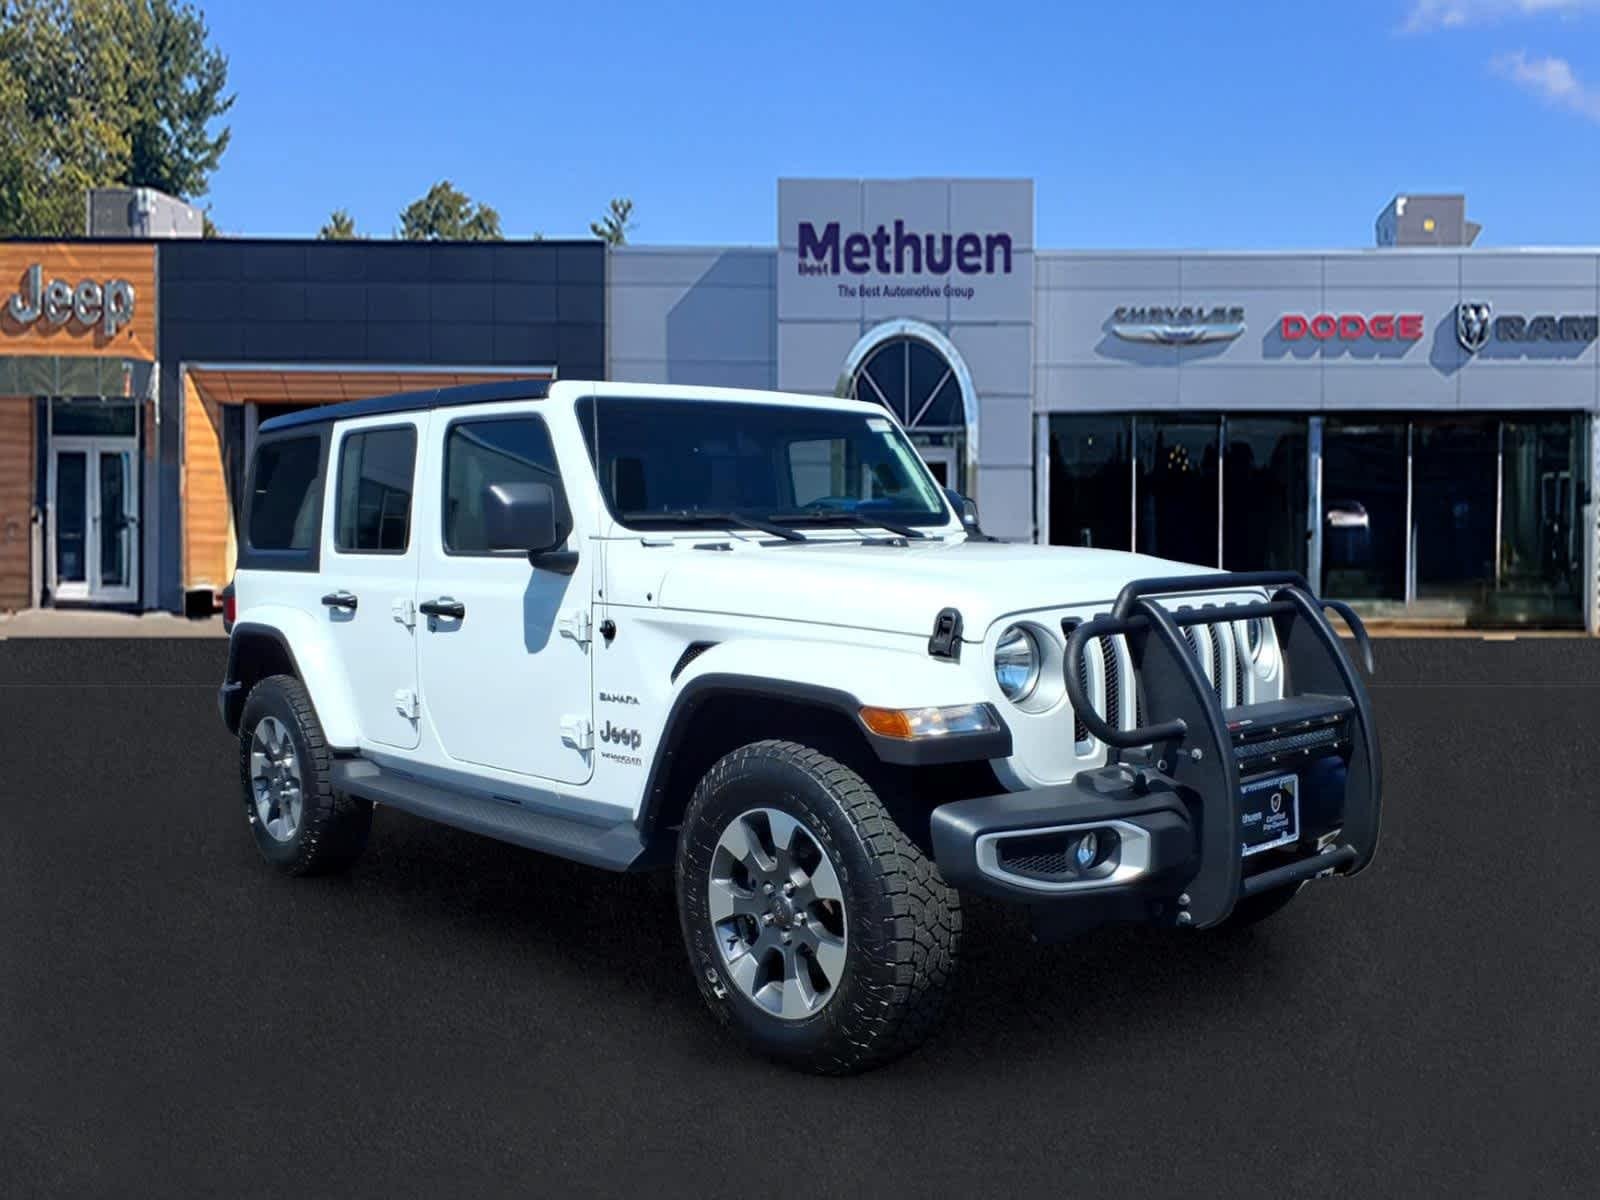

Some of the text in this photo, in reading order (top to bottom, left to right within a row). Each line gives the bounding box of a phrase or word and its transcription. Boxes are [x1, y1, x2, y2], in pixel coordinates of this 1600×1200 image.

[798, 220, 1012, 275] Methuen
[798, 263, 829, 276] Best
[9, 263, 135, 336] Jeep
[838, 284, 975, 300] The Best Automotive Group
[1113, 305, 1245, 322] CHRYSLER
[1281, 313, 1424, 339] DODGE
[1495, 314, 1599, 342] RAM
[599, 691, 640, 705] SAHARA
[599, 719, 642, 751] Jeep
